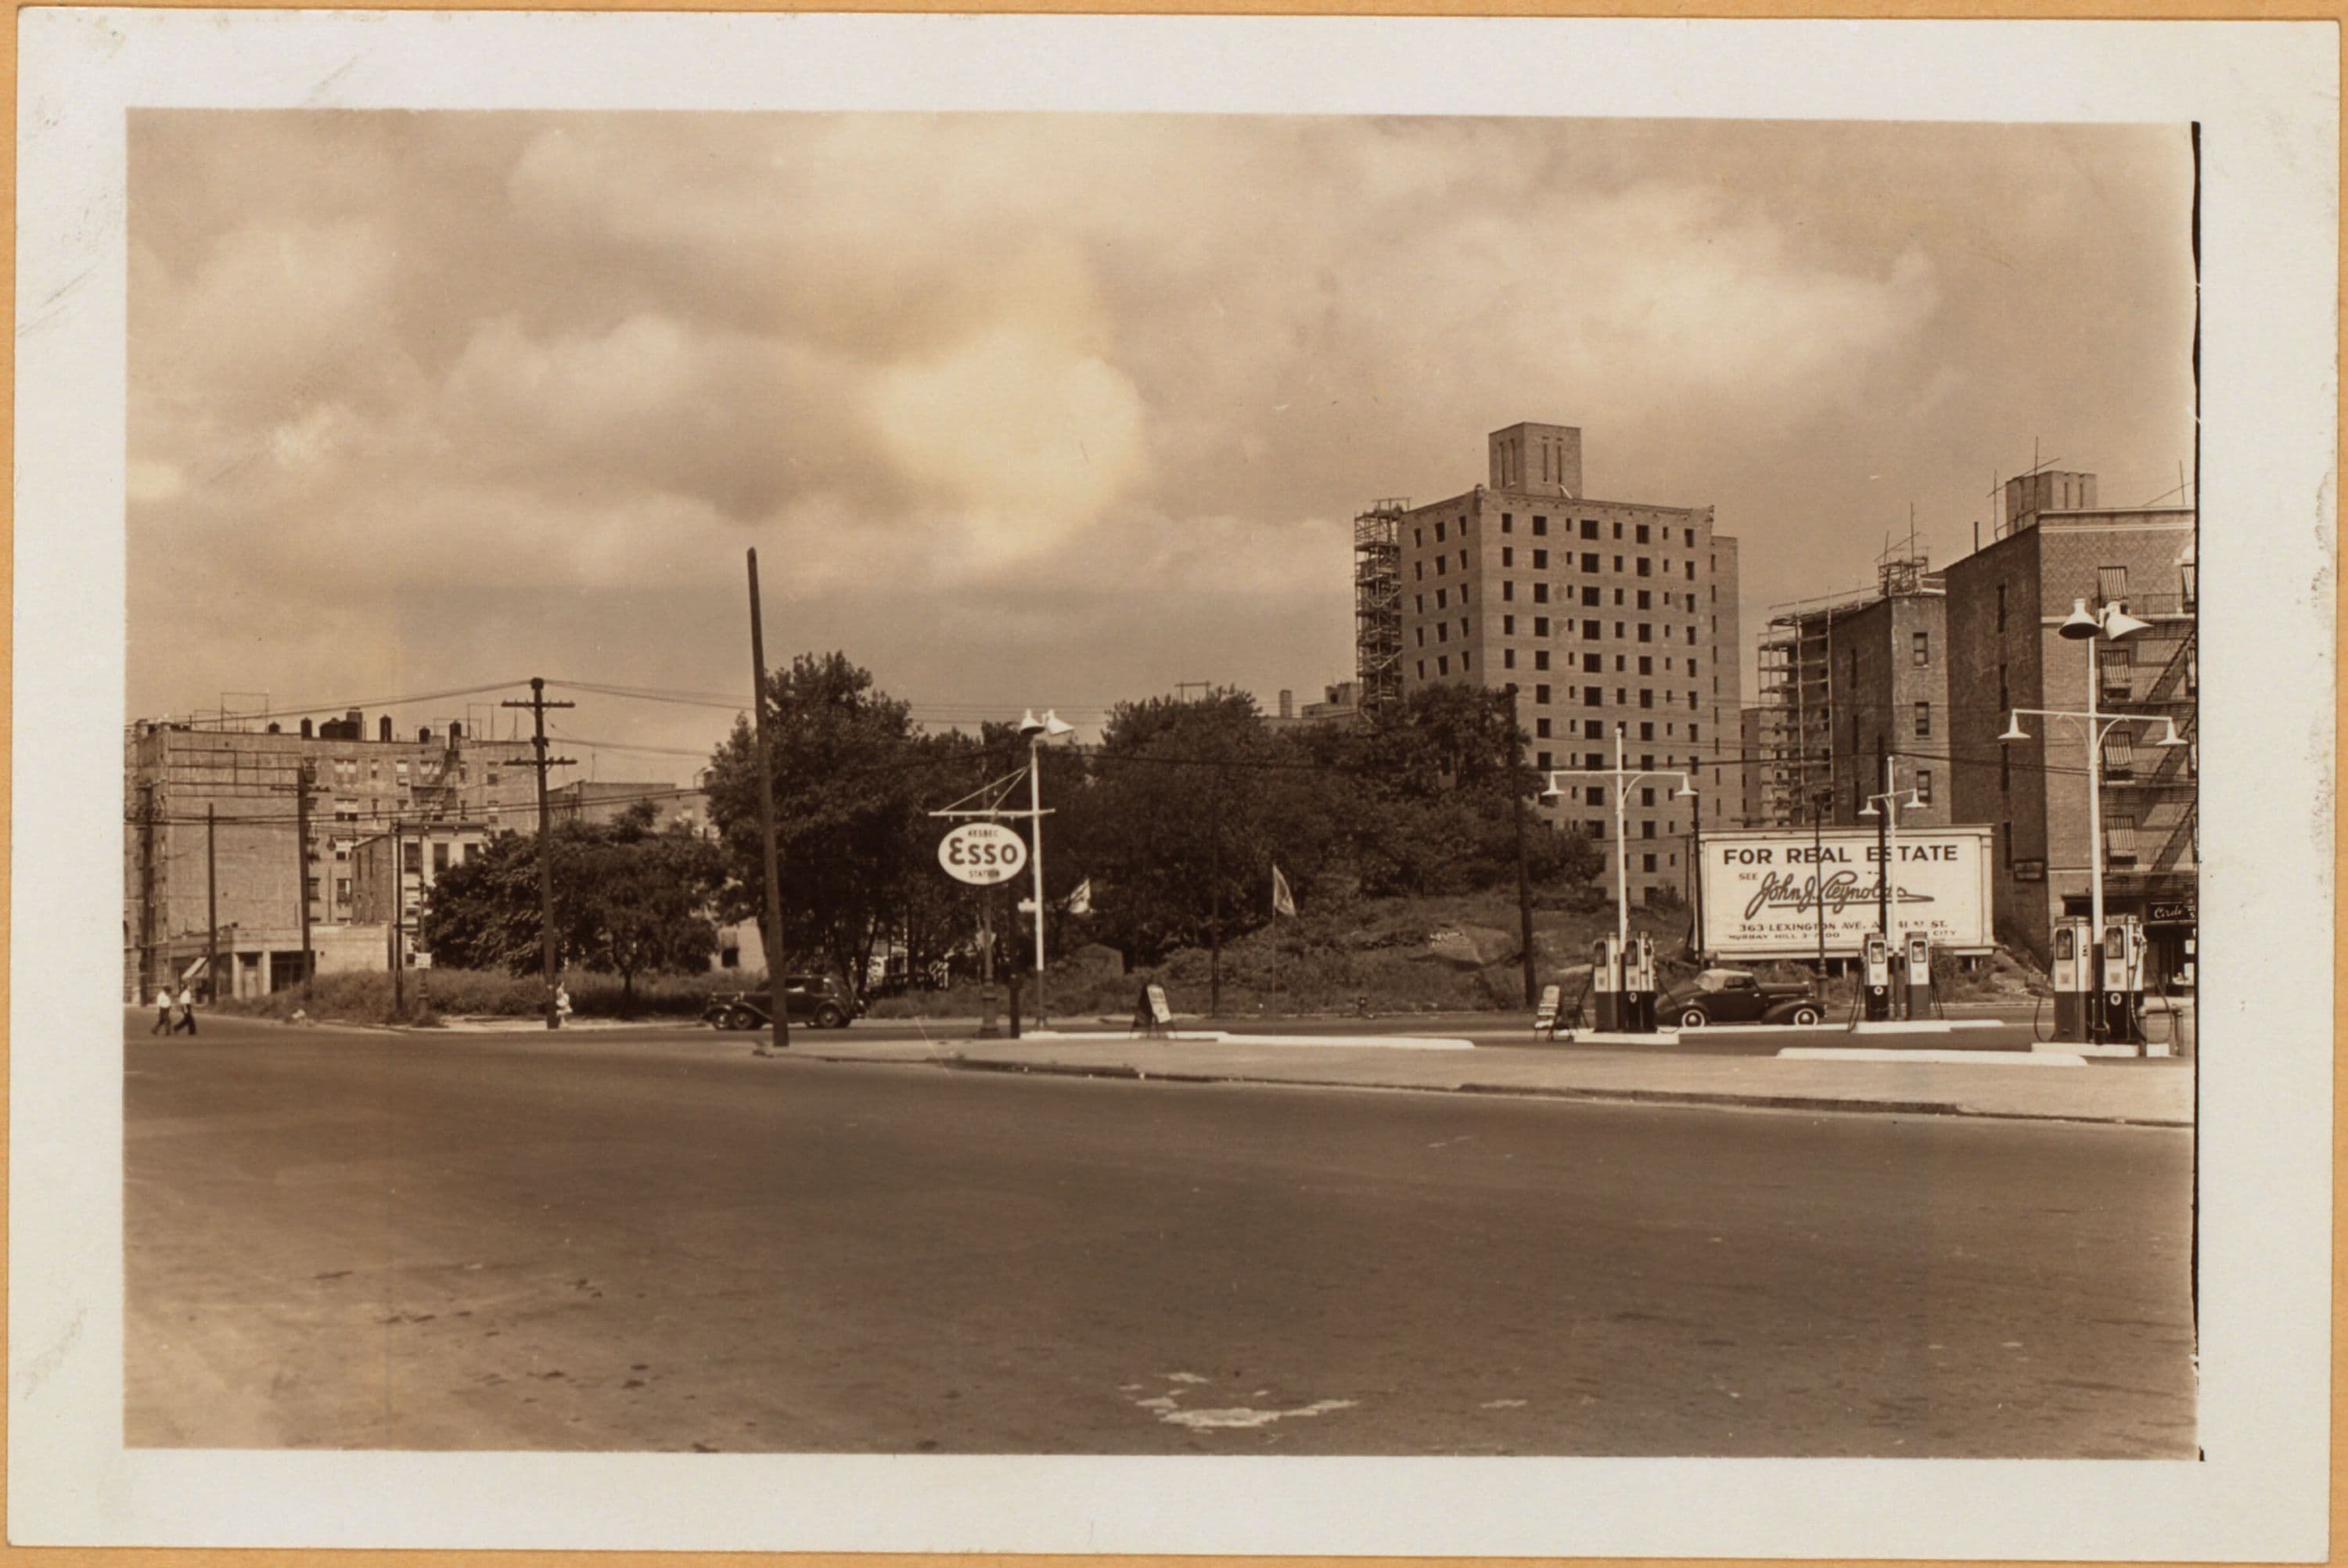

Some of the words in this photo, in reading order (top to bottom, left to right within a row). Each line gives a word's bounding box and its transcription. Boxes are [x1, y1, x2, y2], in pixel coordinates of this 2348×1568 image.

[948, 836, 1018, 865] ESSO
[1724, 848, 1772, 865] FOR
[1786, 847, 1851, 864] REAL
[1866, 844, 1958, 862] ESTATE
[1739, 872, 1758, 881] SEE
[1744, 870, 1803, 921] John
[1739, 922, 1764, 933] 363
[1769, 922, 1836, 932] LEXINGTON
[1841, 920, 1866, 930] AVE.
